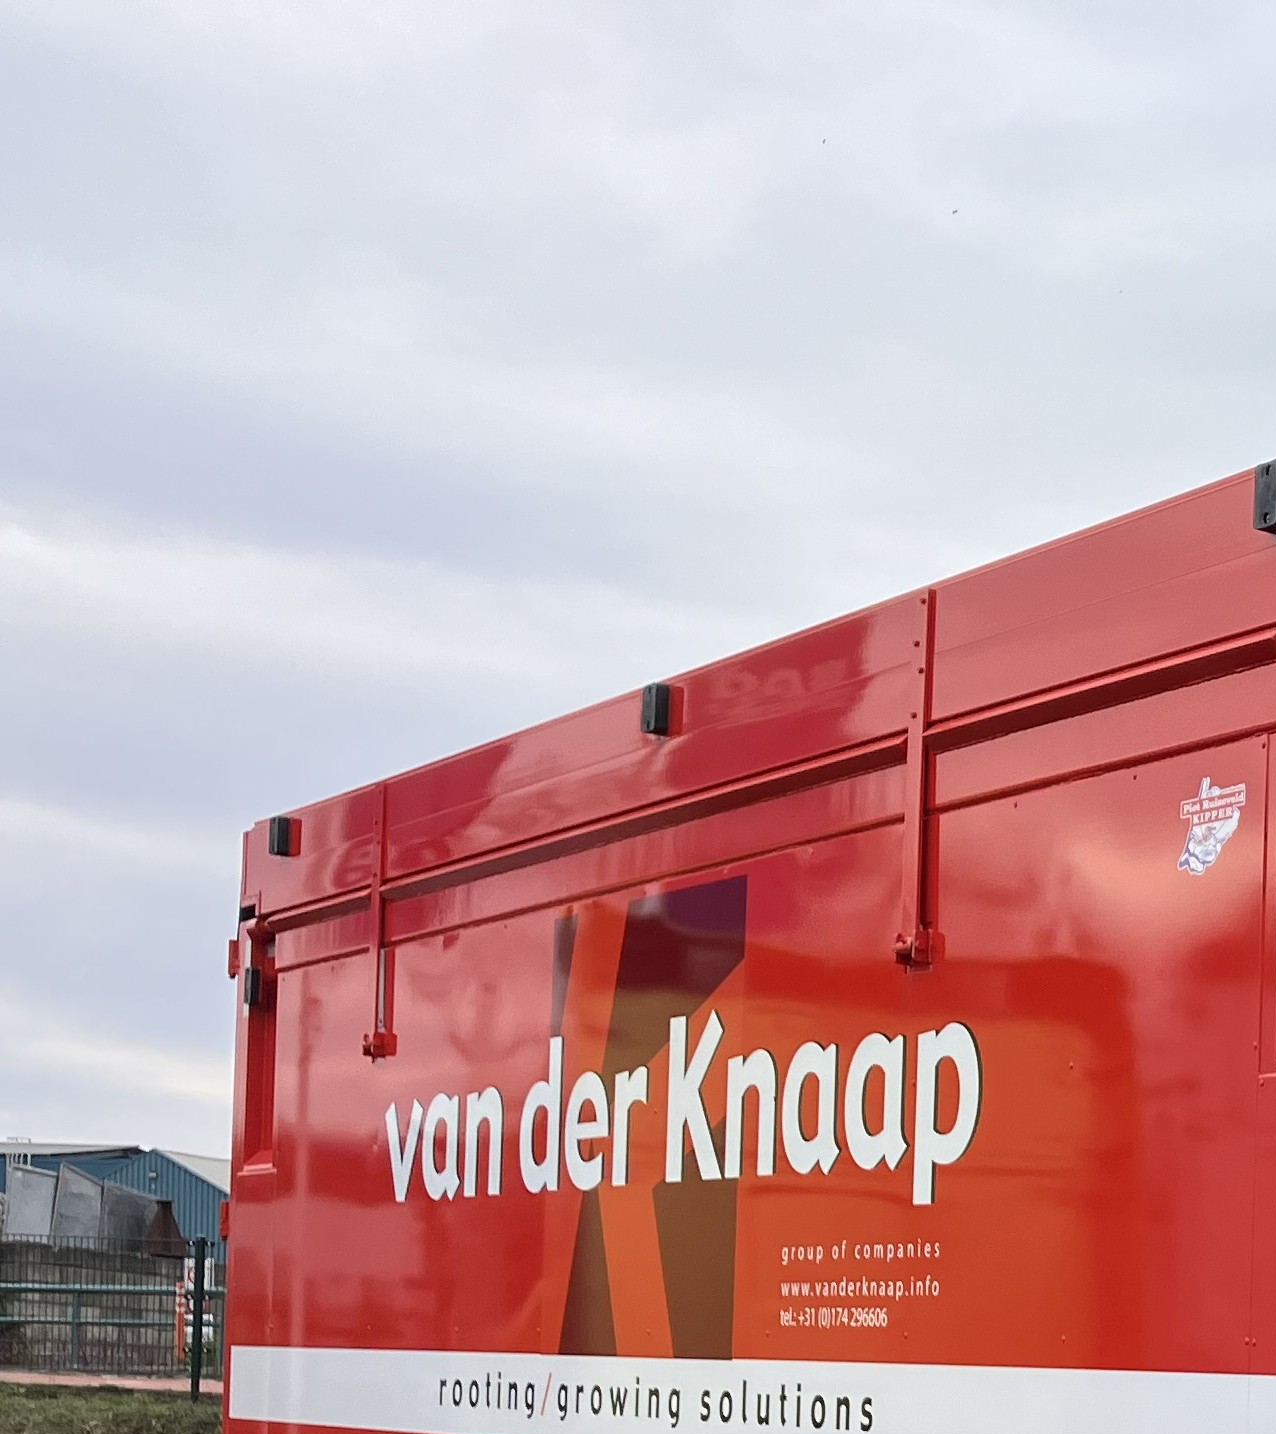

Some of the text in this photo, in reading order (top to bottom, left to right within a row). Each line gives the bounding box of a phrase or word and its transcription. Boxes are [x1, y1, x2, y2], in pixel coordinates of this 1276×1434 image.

[384, 1009, 983, 1206] van der Knaap
[781, 1238, 941, 1266] group of companies
[780, 1274, 940, 1302] www.vanderknaap.info
[850, 1307, 888, 1328] 296606
[438, 1371, 875, 1433] rooting/growing solutions
